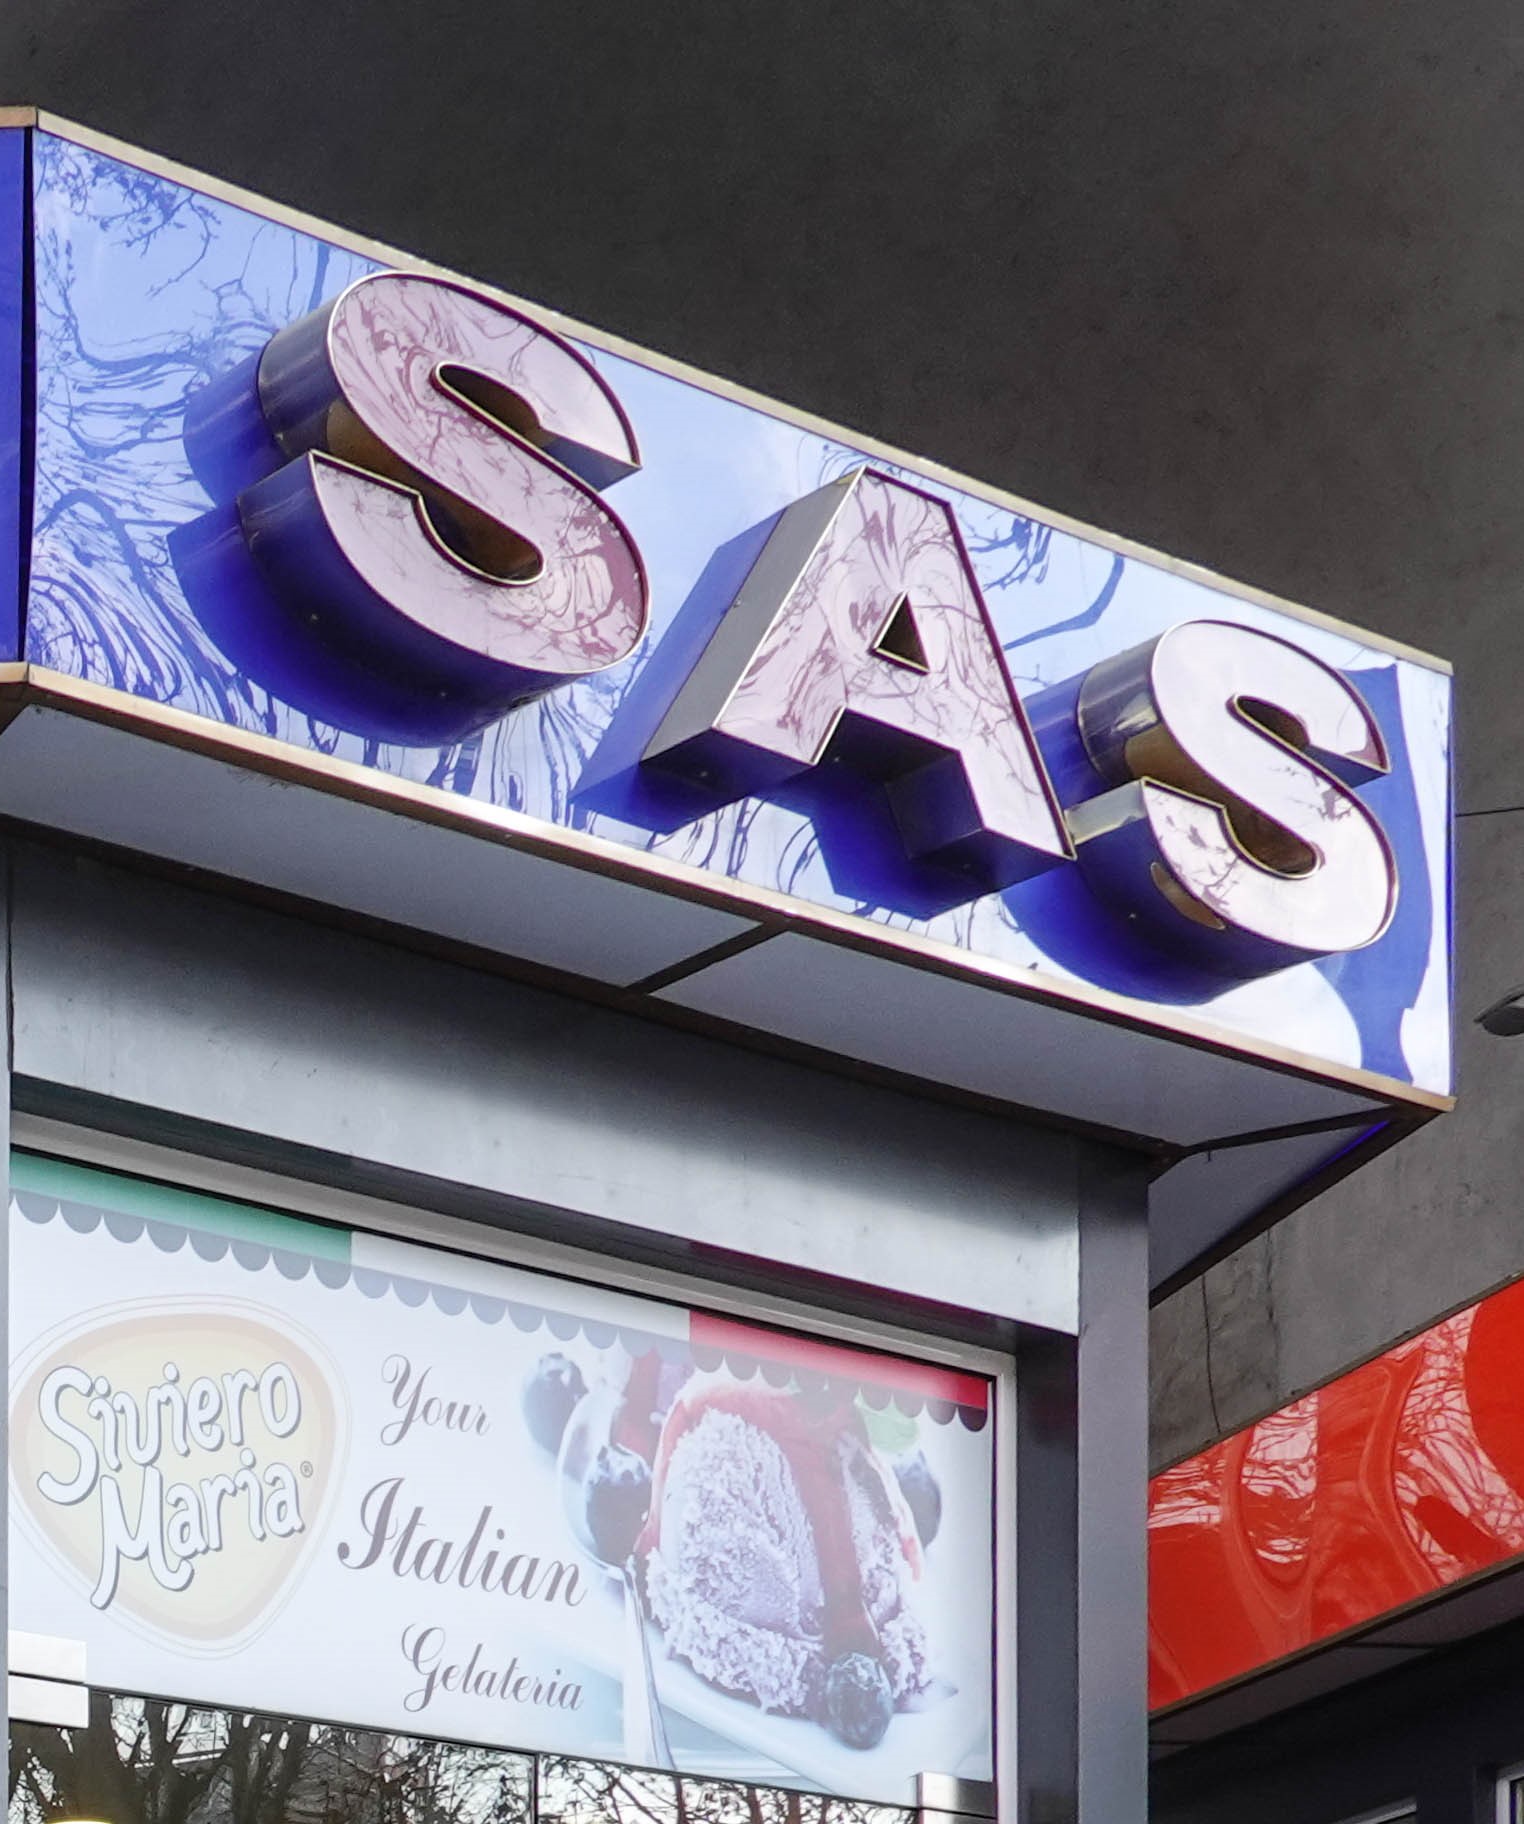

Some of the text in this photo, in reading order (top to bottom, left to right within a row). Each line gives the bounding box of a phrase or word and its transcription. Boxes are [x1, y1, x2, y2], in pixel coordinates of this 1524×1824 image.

[292, 268, 1400, 958] SAS
[37, 1361, 303, 1506] Siviero
[380, 1353, 491, 1446] Your
[89, 1446, 305, 1611] Maria
[337, 1477, 587, 1607] Italian
[401, 1623, 583, 1712] Gelateria
